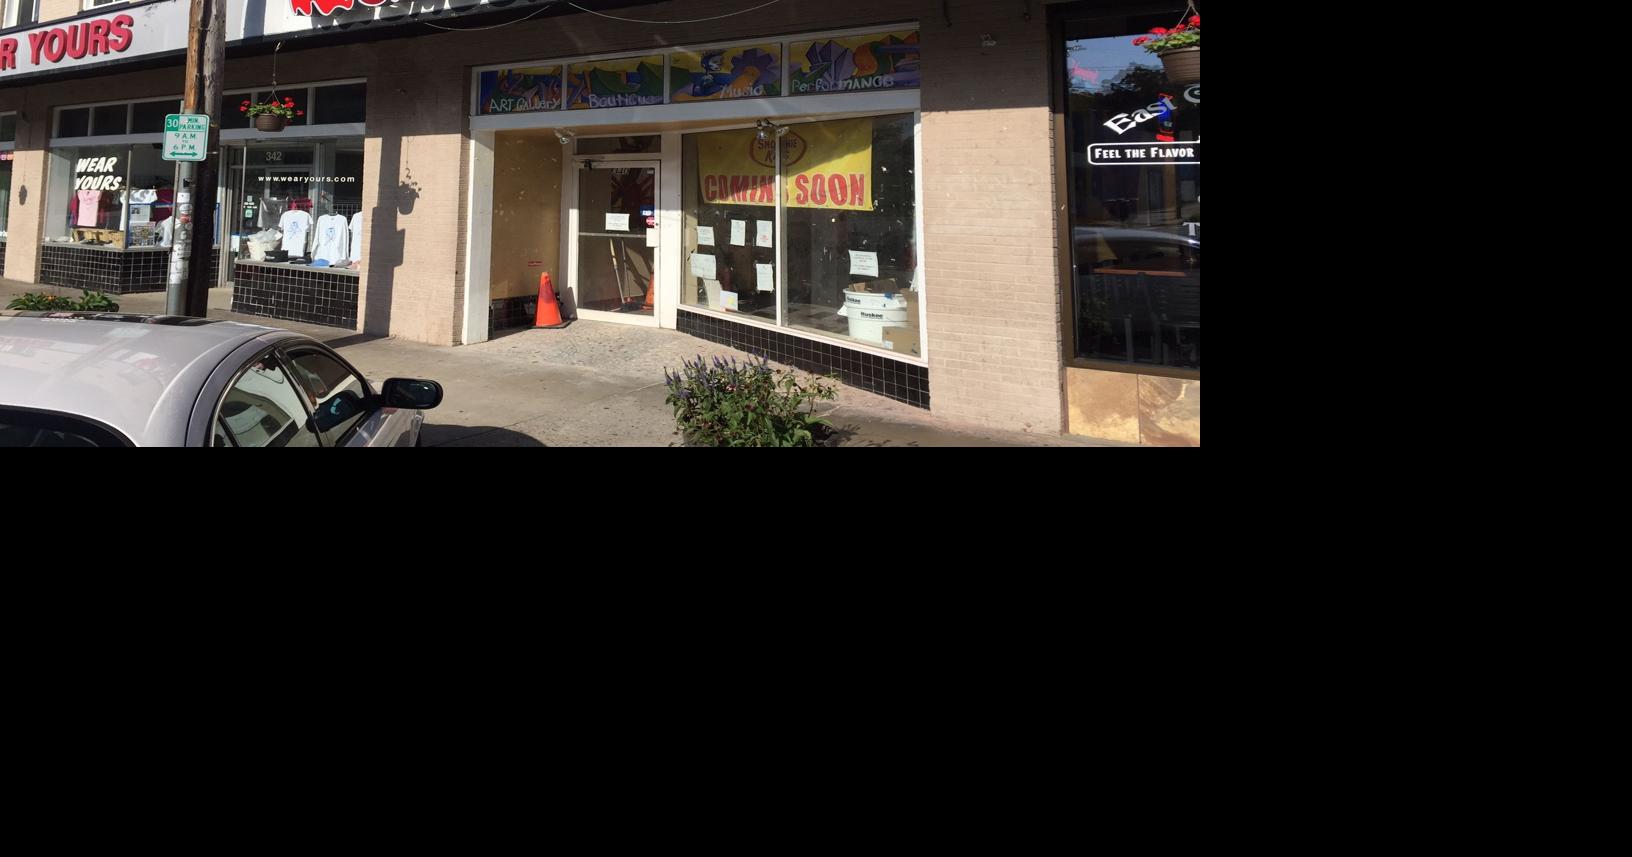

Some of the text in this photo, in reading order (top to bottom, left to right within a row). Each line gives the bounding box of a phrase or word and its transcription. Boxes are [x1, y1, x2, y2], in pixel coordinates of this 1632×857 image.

[28, 14, 134, 65] YOURS
[489, 99, 512, 112] ART
[167, 118, 179, 128] 30
[265, 151, 282, 161] 342
[76, 156, 118, 173] WEAR
[74, 174, 123, 191] YOURS
[258, 175, 355, 183] www.wearyours.com
[704, 173, 865, 206] COMIN SOON
